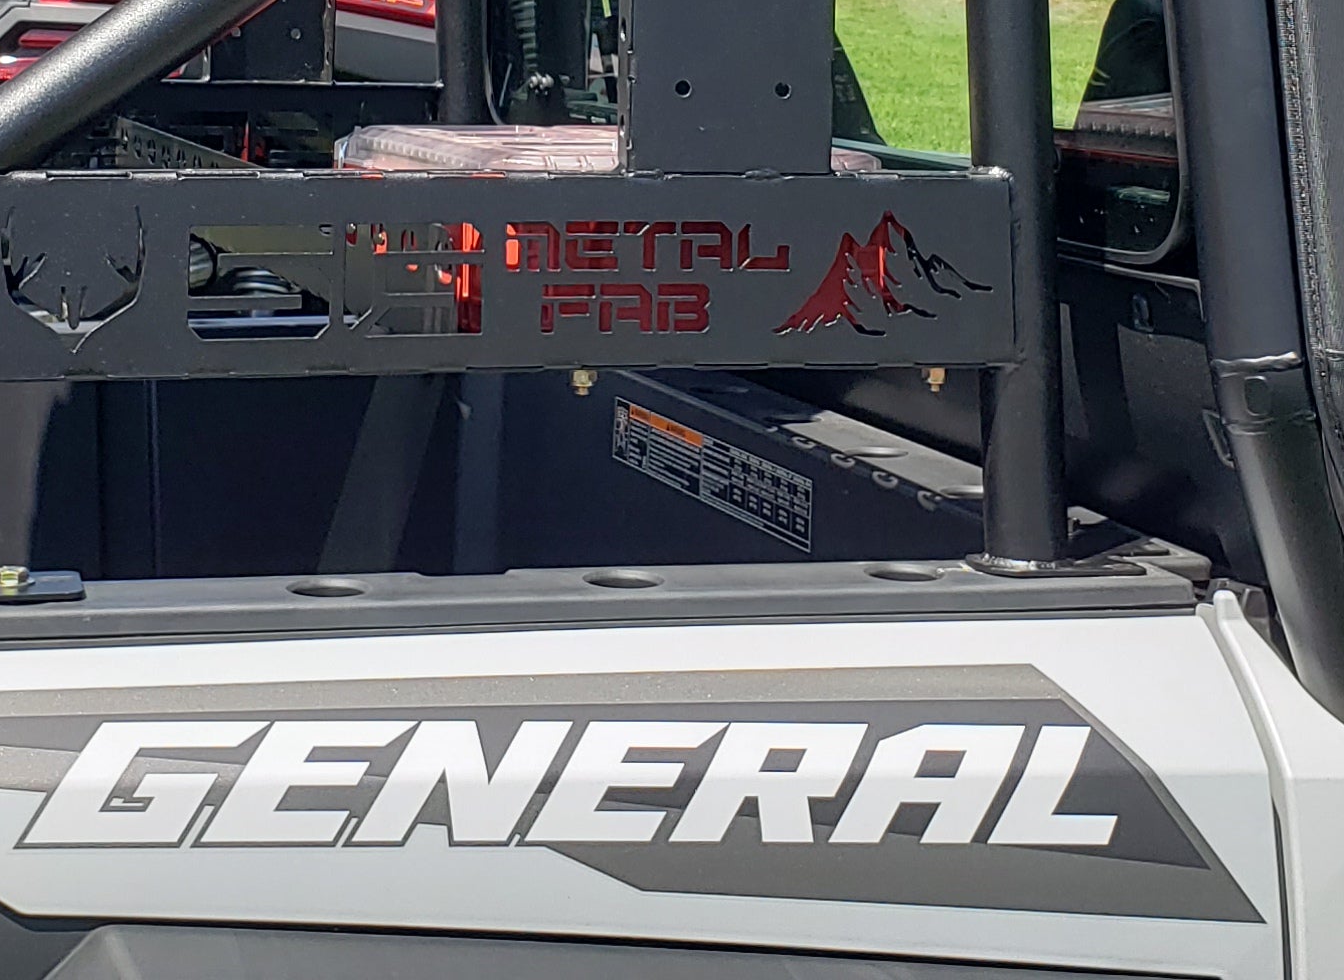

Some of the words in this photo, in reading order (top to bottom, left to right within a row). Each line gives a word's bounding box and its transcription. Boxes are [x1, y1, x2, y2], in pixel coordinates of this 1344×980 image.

[505, 220, 791, 272] METAL
[541, 283, 711, 335] FAB
[14, 720, 1123, 849] GENERAL
